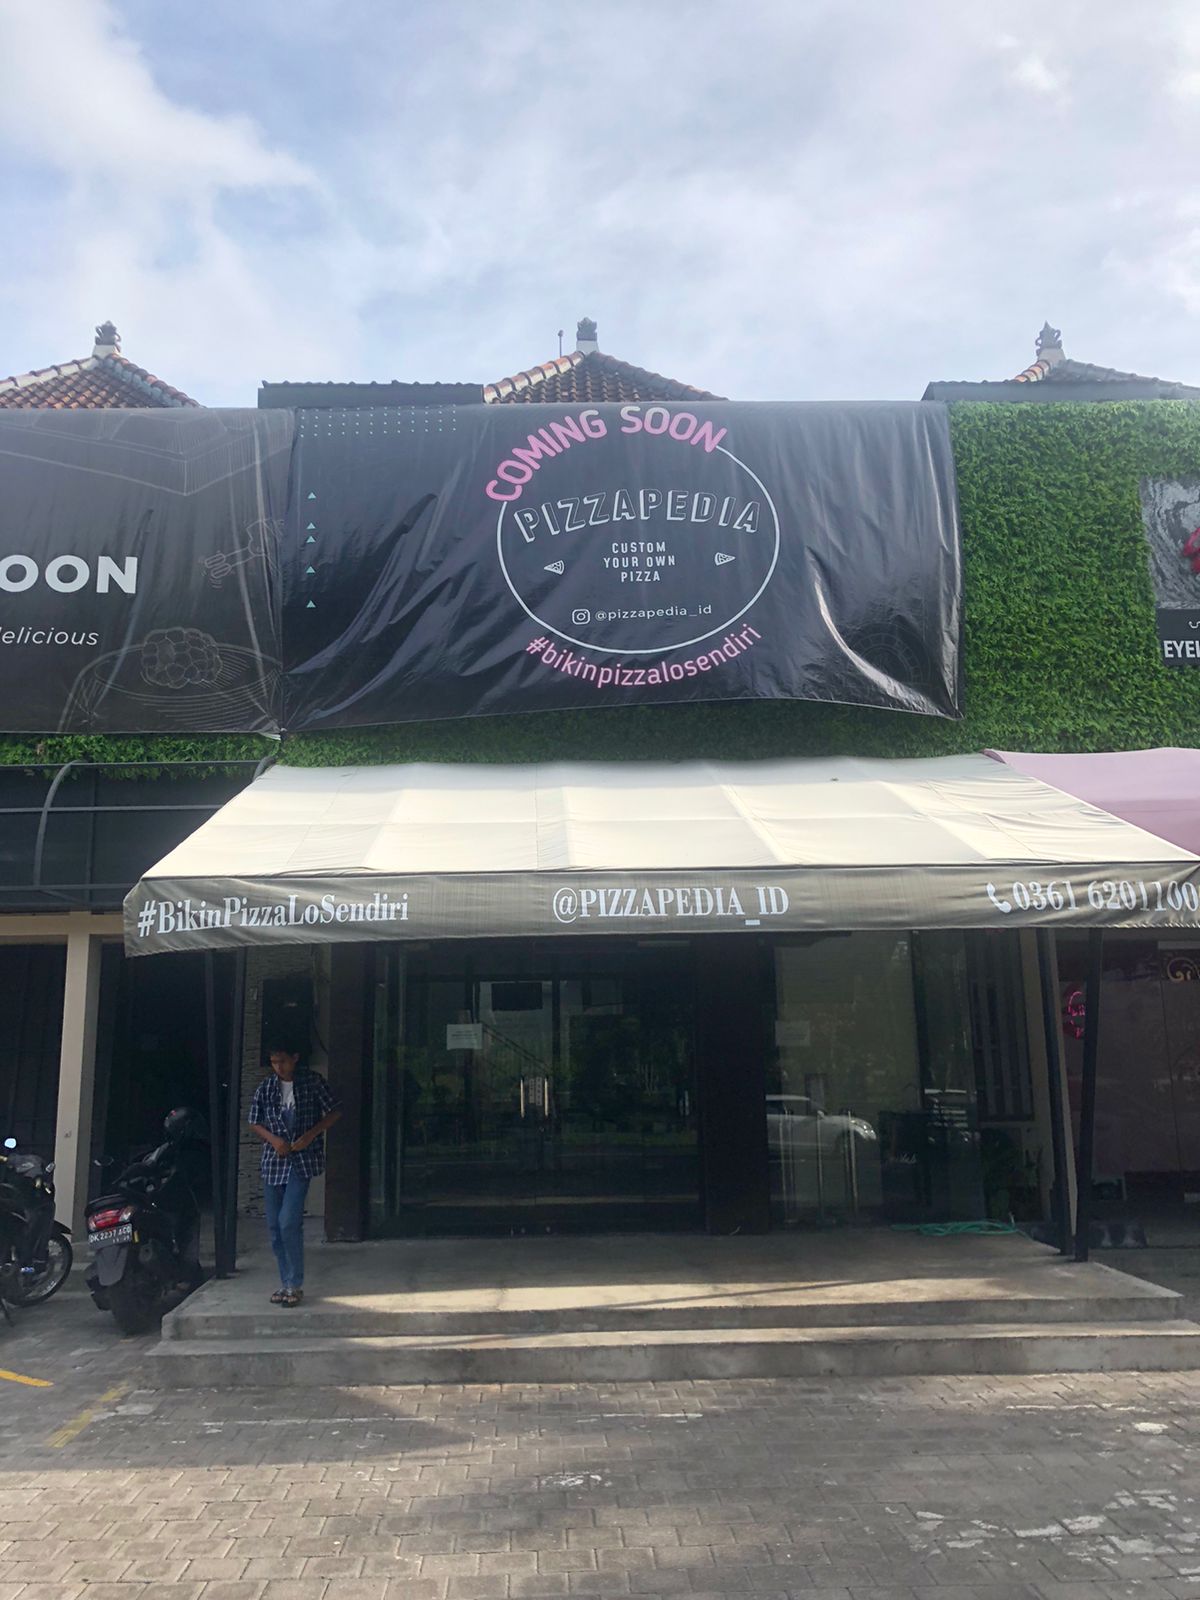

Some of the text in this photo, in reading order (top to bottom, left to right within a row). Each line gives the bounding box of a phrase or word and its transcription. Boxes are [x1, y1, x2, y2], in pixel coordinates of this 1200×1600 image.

[486, 405, 728, 502] COMING SOON
[513, 488, 761, 543] PIZZAPEDIA
[603, 555, 676, 569] YOUR OWN
[611, 541, 667, 554] CUSTOM
[620, 571, 661, 583] PIZZA
[595, 604, 712, 621] @pizzapedia_id
[0, 626, 100, 646] elicious
[525, 622, 763, 689] #bikinpizzalosendiri
[552, 886, 790, 926] @PIZZAPEDIA_ID
[1012, 880, 1200, 912] 0361 6201100
[137, 892, 409, 938] #BikinPizzaLoSendiri
